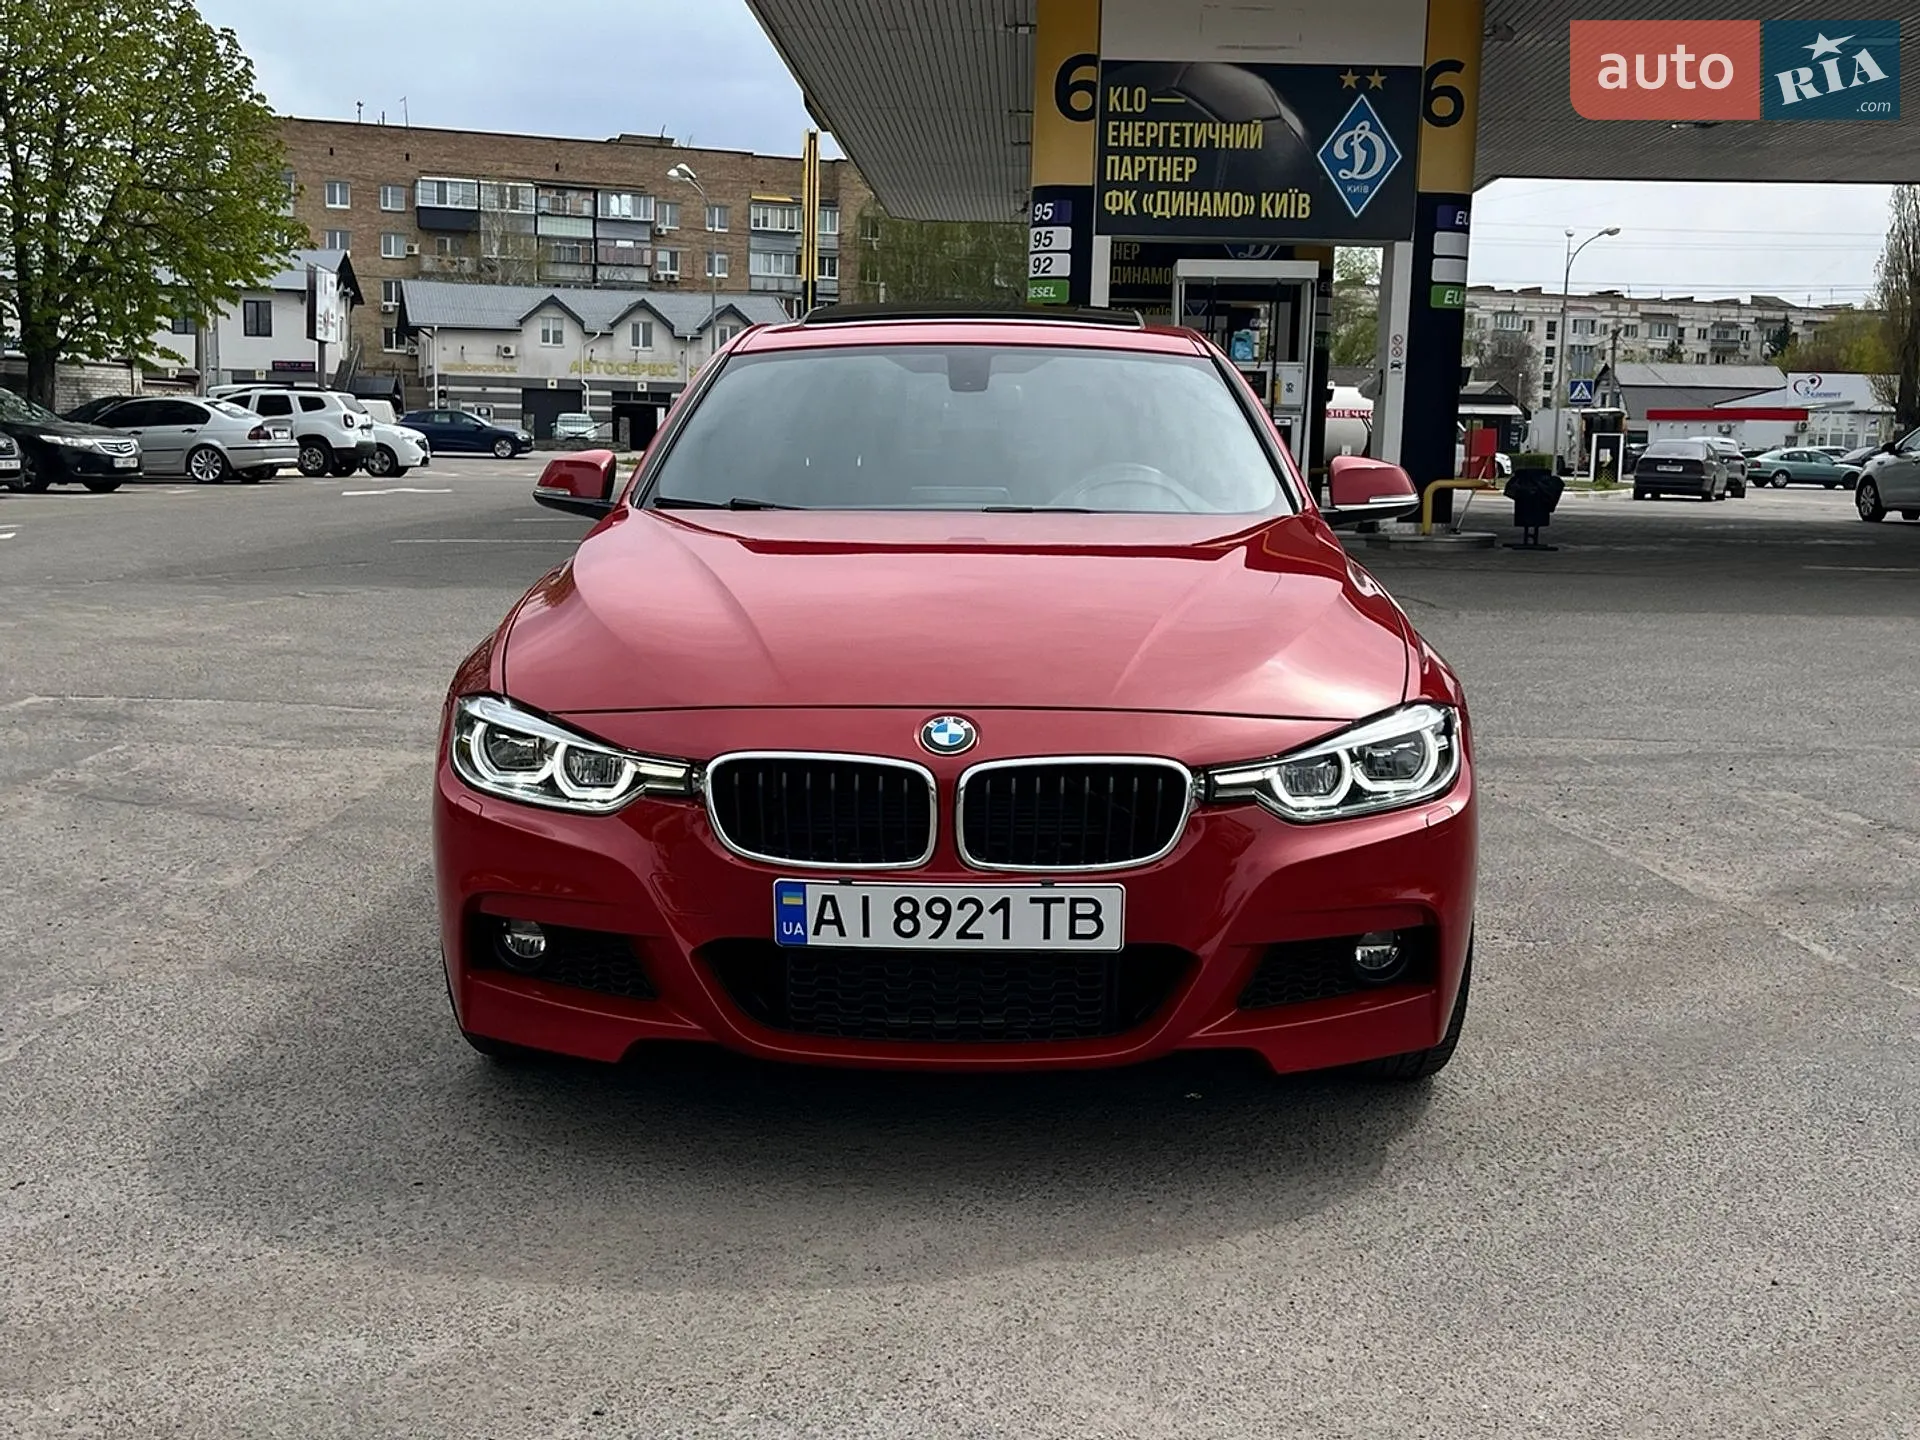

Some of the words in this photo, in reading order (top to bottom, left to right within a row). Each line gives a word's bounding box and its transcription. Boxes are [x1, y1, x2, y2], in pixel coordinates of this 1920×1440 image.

[1055, 53, 1098, 122] 6
[1108, 86, 1147, 113] KLO
[1422, 59, 1465, 128] 6
[1106, 119, 1263, 149] ЕНЕРГЕТИЧНИЙ
[1105, 155, 1197, 182] ПАРТНЕР
[1347, 184, 1369, 194] КИЇВ
[1034, 202, 1054, 221] 95
[1104, 189, 1138, 216] ФК
[1142, 190, 1255, 219] «ДИНАМО»
[1260, 188, 1311, 219] КИЇВ
[1033, 230, 1054, 249] 95
[1032, 256, 1053, 275] 92
[782, 921, 805, 936] UA
[812, 894, 871, 938] AI
[893, 896, 1010, 940] 8921
[1029, 897, 1105, 941] TB
